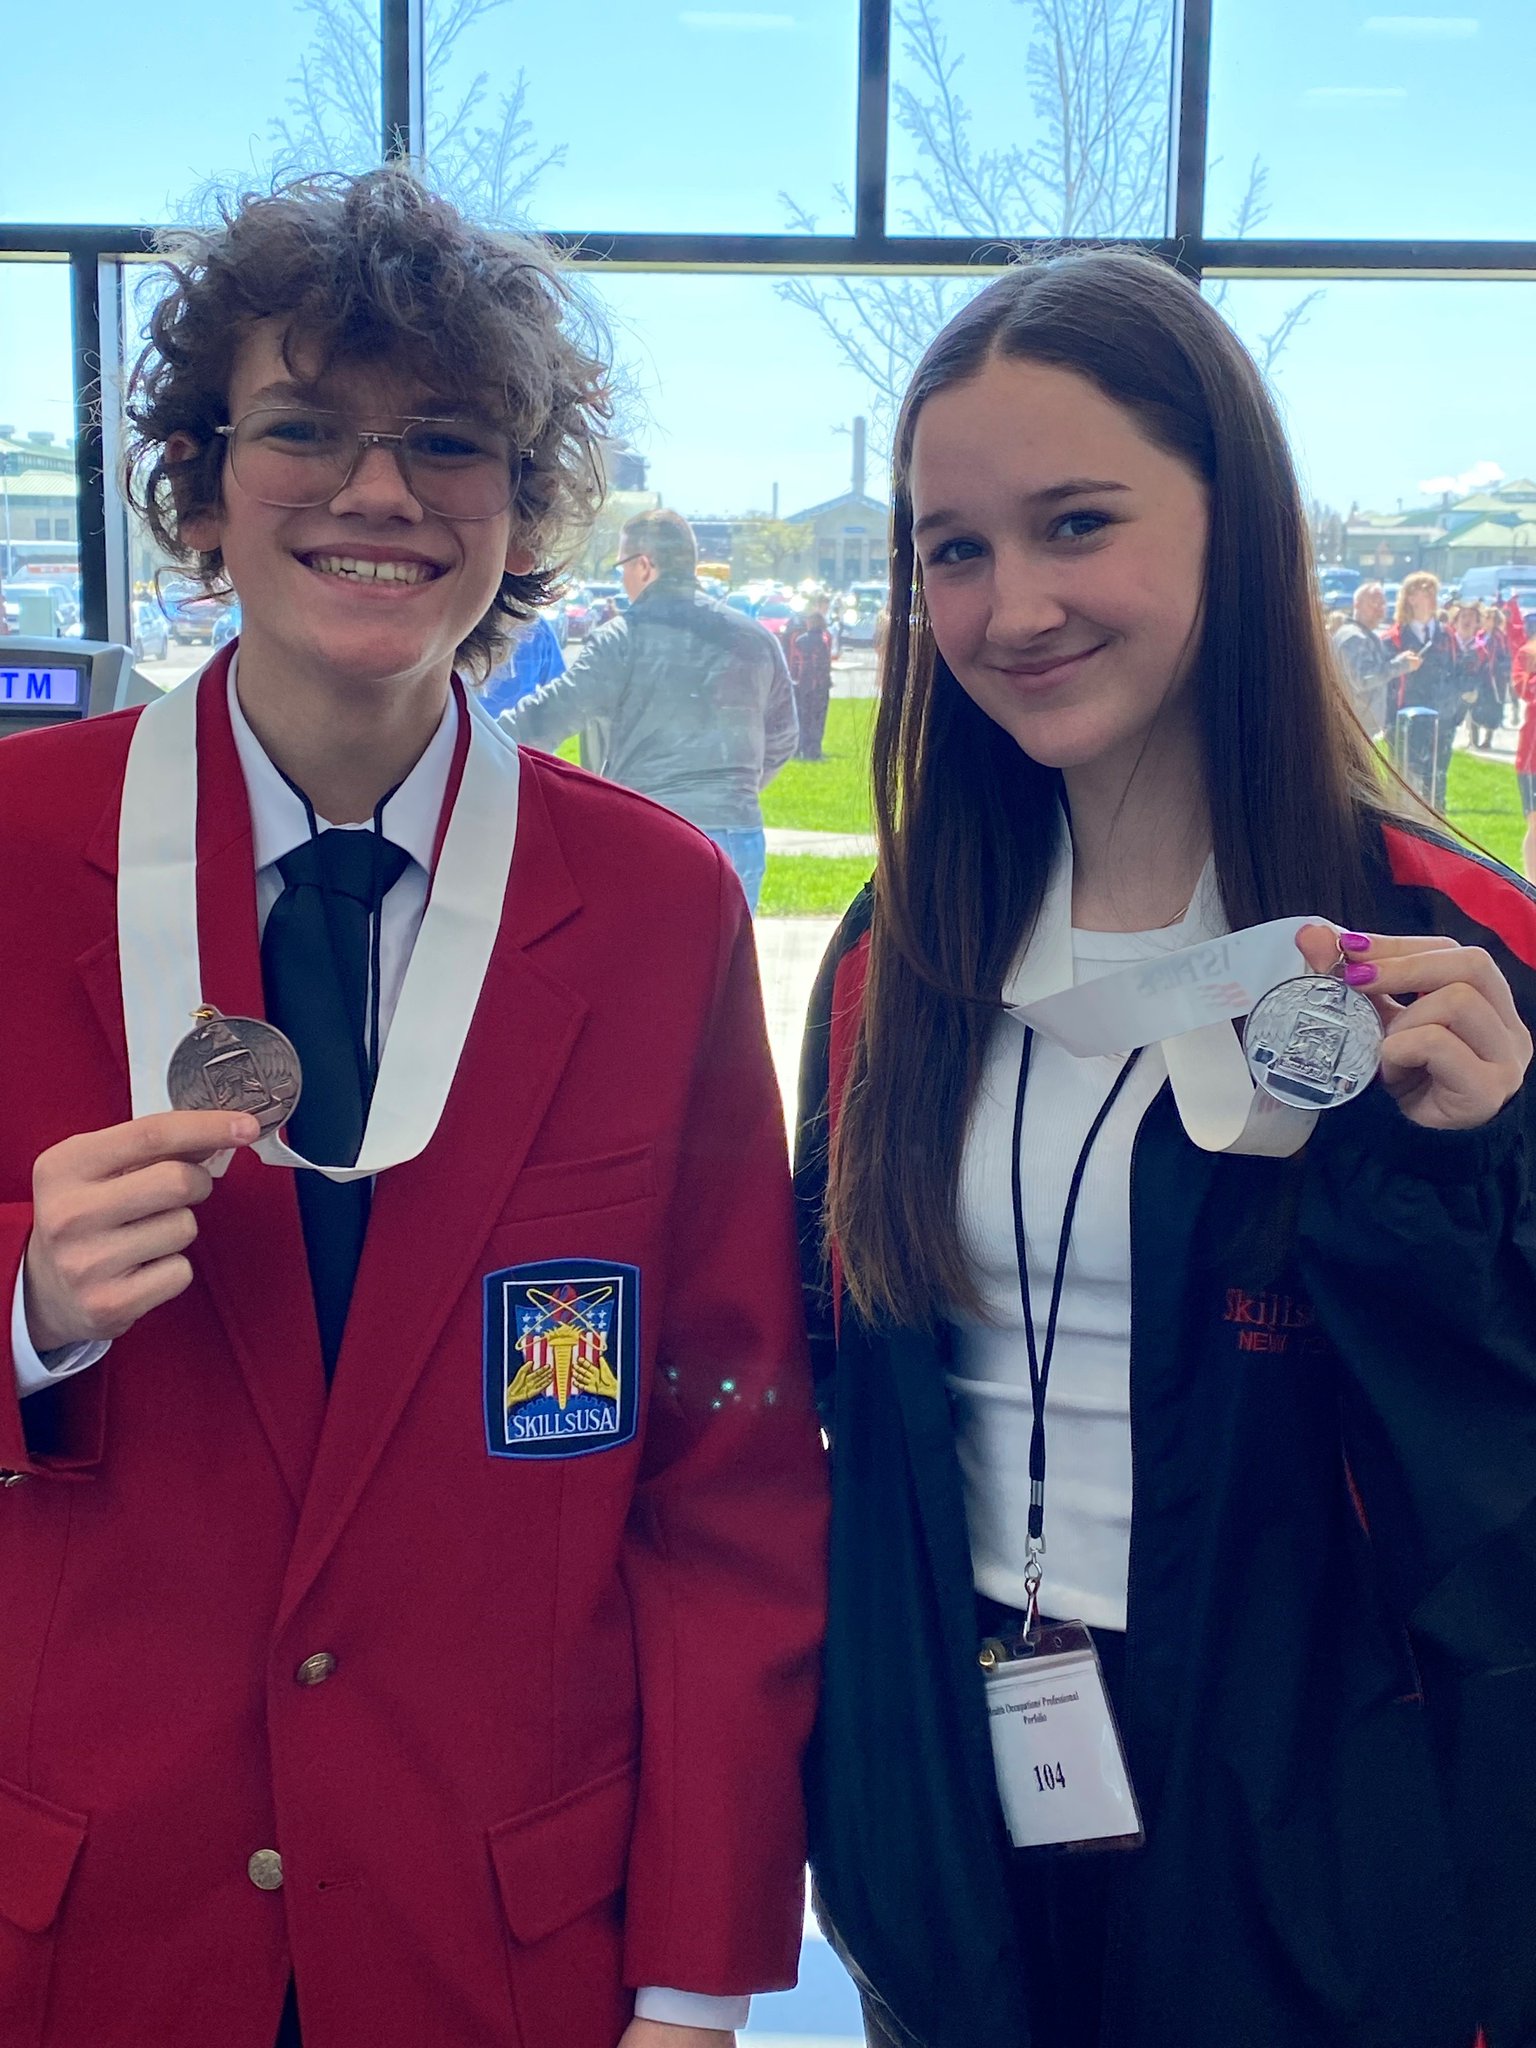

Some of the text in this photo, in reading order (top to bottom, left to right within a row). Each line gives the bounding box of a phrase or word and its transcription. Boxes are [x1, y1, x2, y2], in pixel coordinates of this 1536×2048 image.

[512, 1407, 615, 1438] SKILLSUSA
[1042, 1691, 1080, 1706] Professional
[1033, 1761, 1066, 1792] 104
